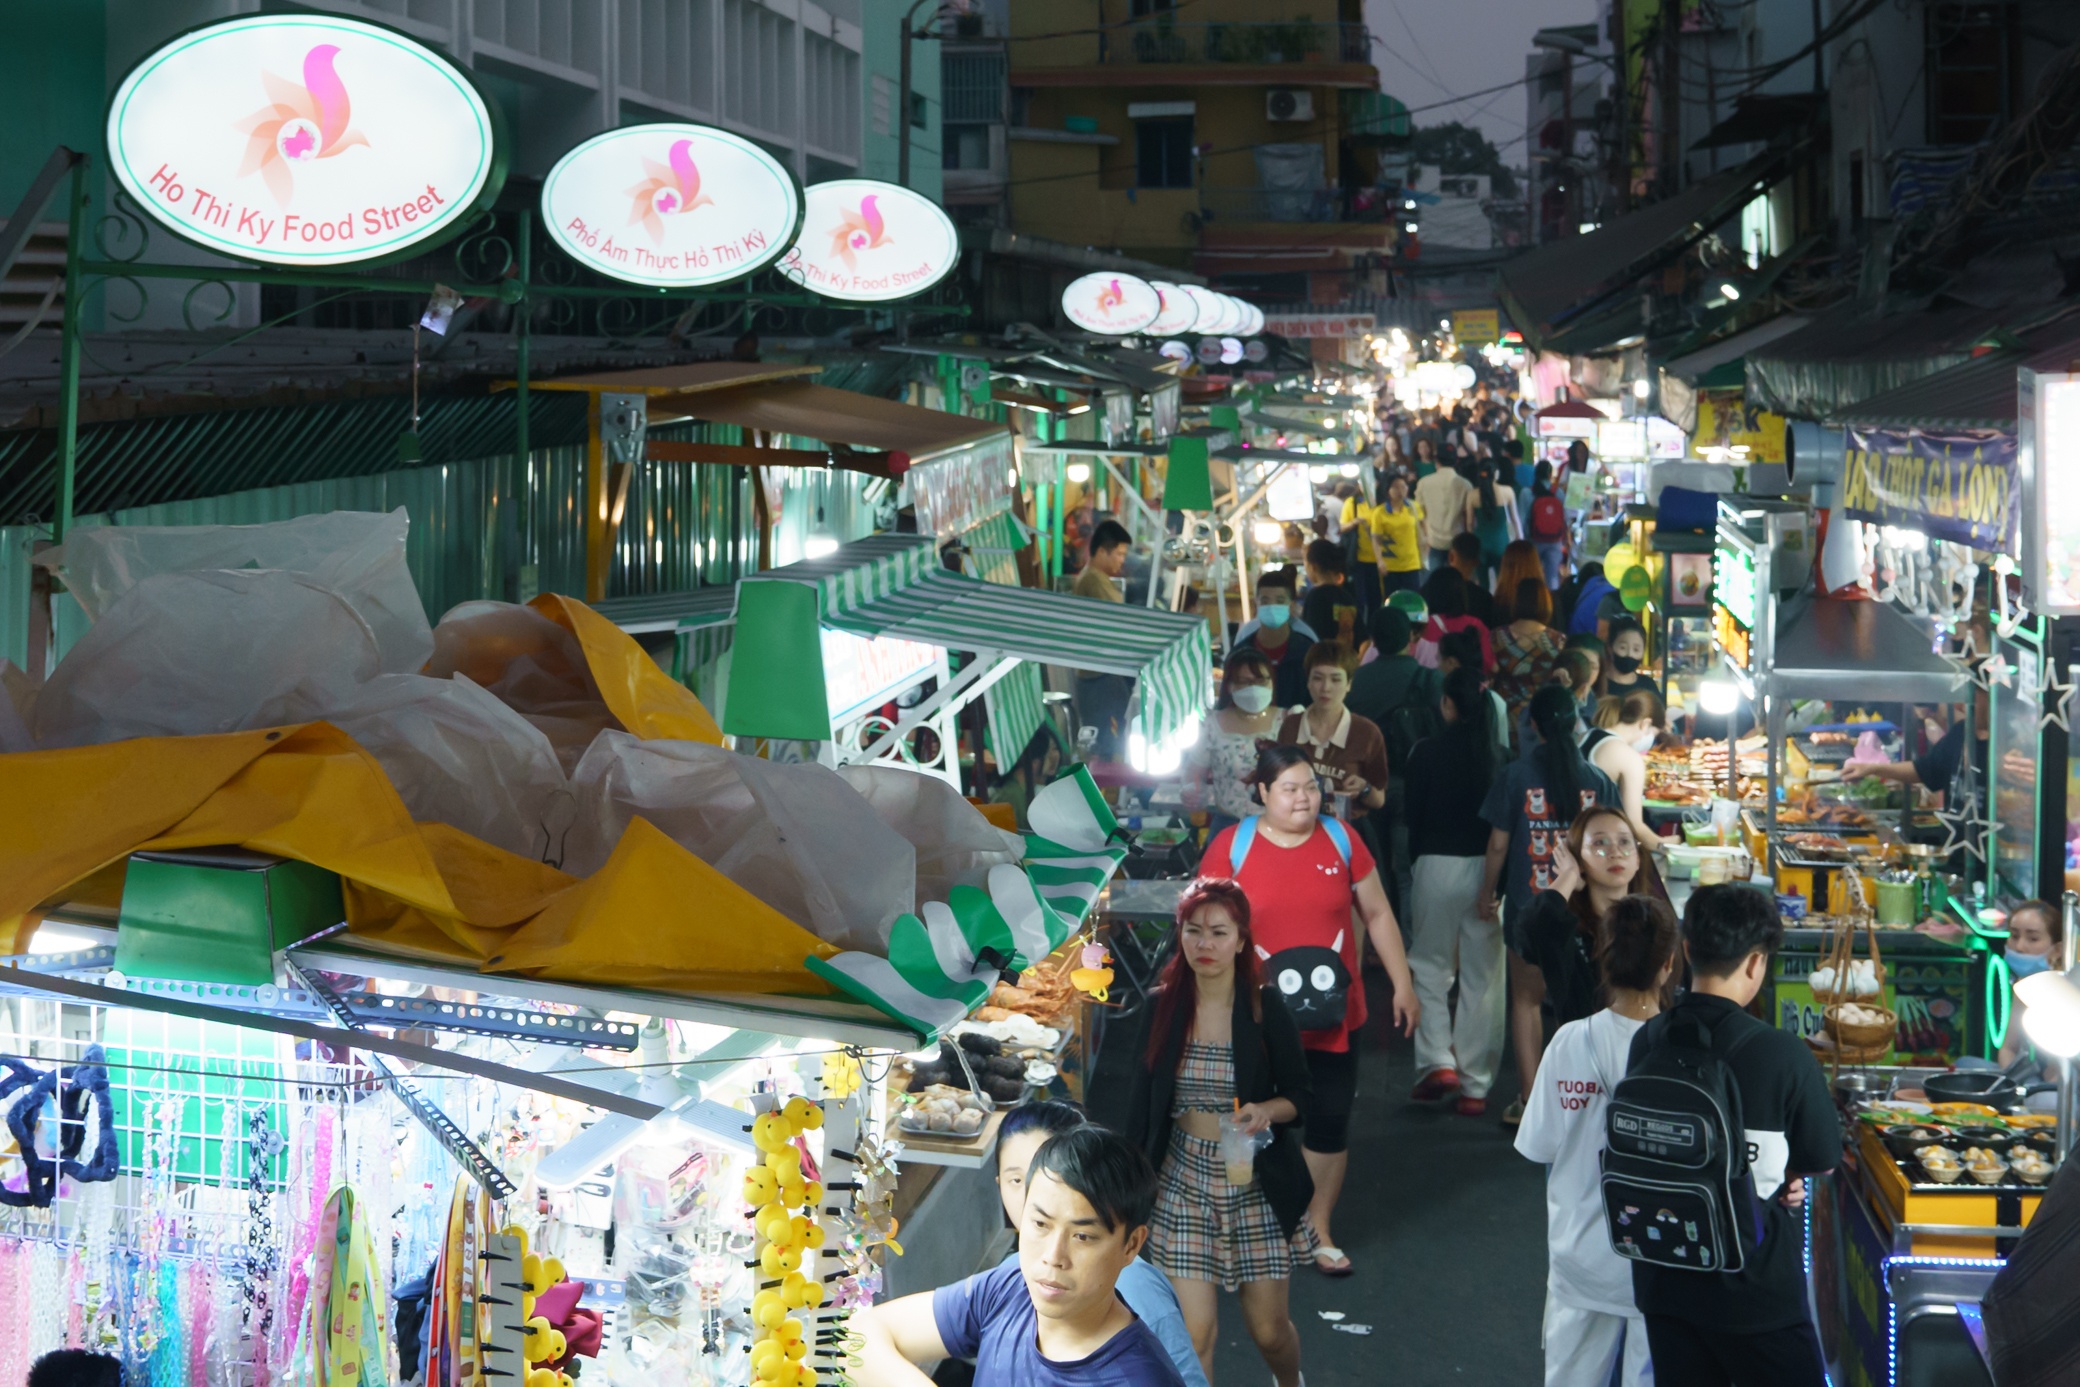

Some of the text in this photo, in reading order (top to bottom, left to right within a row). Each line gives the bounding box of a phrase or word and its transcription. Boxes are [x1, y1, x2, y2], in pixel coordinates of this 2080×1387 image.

[149, 163, 446, 244] Ho Thi Ky Food Street
[567, 217, 601, 249] Phố
[634, 248, 679, 274] Thực
[684, 245, 710, 270] Hồ
[712, 241, 744, 263] Thị
[805, 263, 827, 283] Thi
[830, 272, 849, 291] Ky
[852, 275, 889, 290] Food
[892, 261, 934, 287] Street
